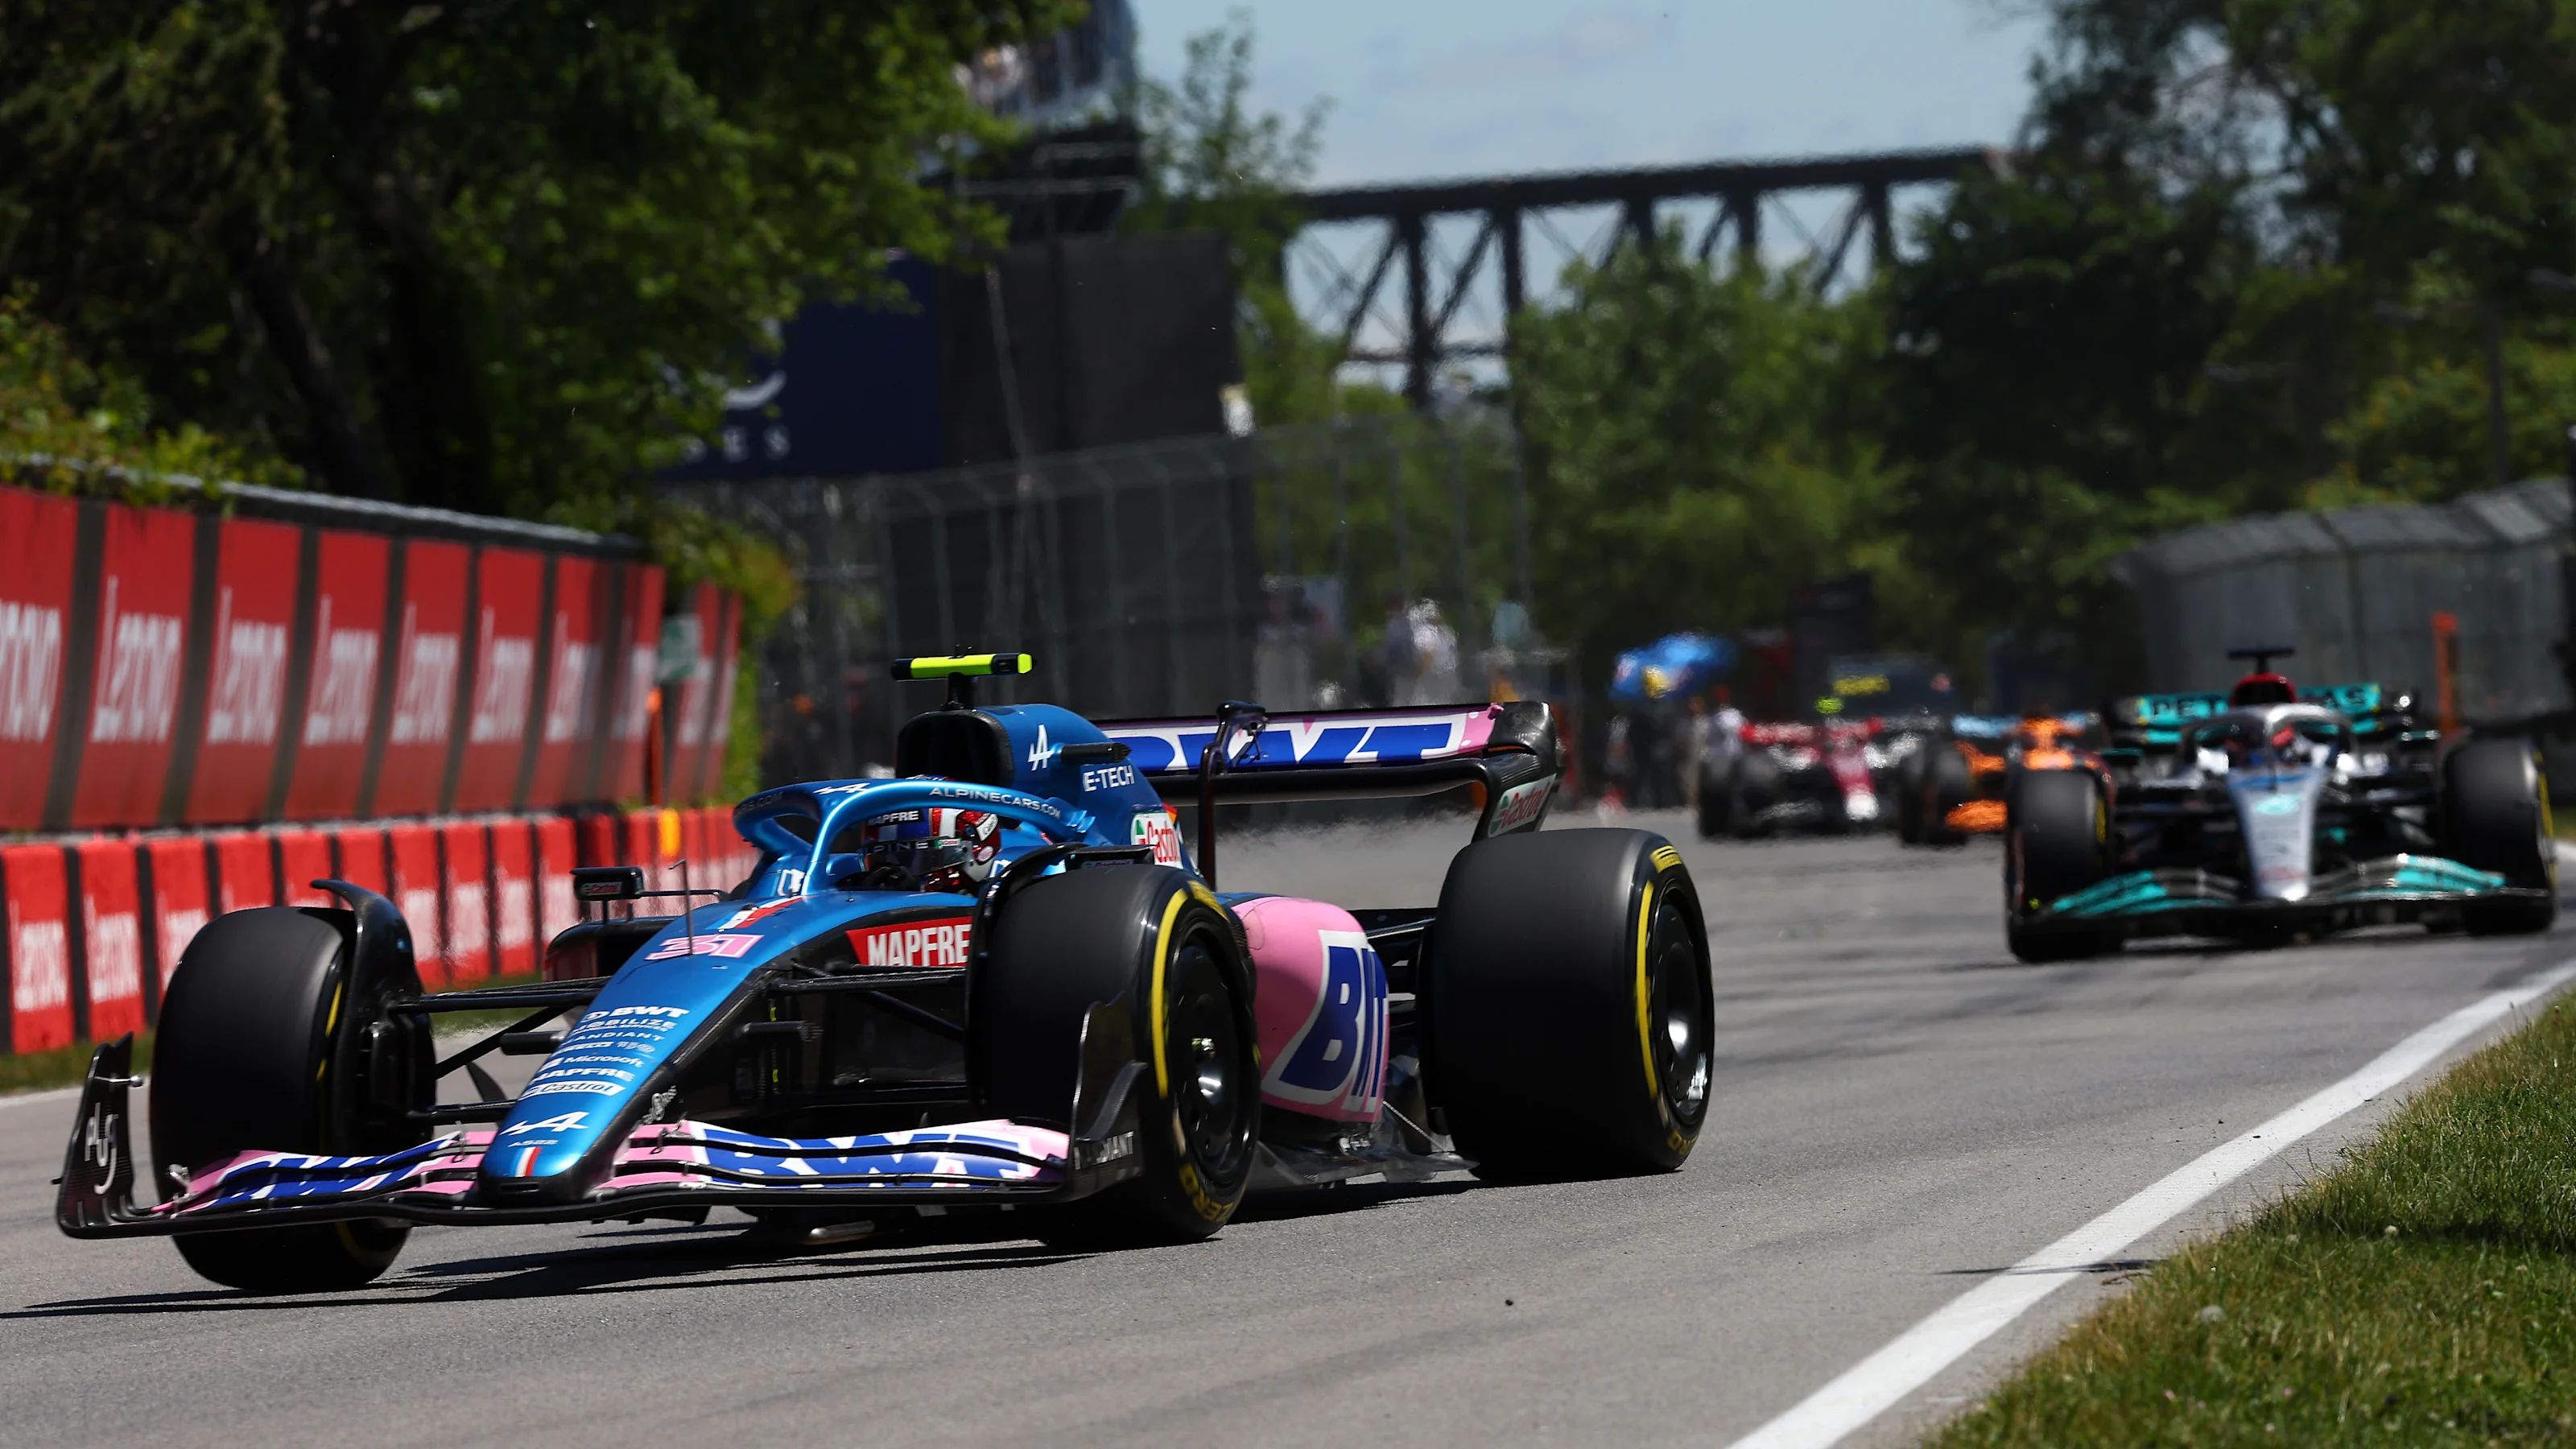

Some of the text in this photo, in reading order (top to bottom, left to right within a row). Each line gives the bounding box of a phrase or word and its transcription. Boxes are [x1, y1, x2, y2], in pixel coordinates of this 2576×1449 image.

[1083, 765, 1135, 792] E-TECH
[929, 786, 1061, 819] ALPINECARS.COM
[1500, 780, 1550, 829] Castrol
[869, 810, 919, 826] MAPFRE
[644, 934, 764, 960] 31
[867, 923, 972, 967] MAPFRE
[609, 1006, 691, 1018] BWT
[564, 1055, 645, 1067] Microsoft
